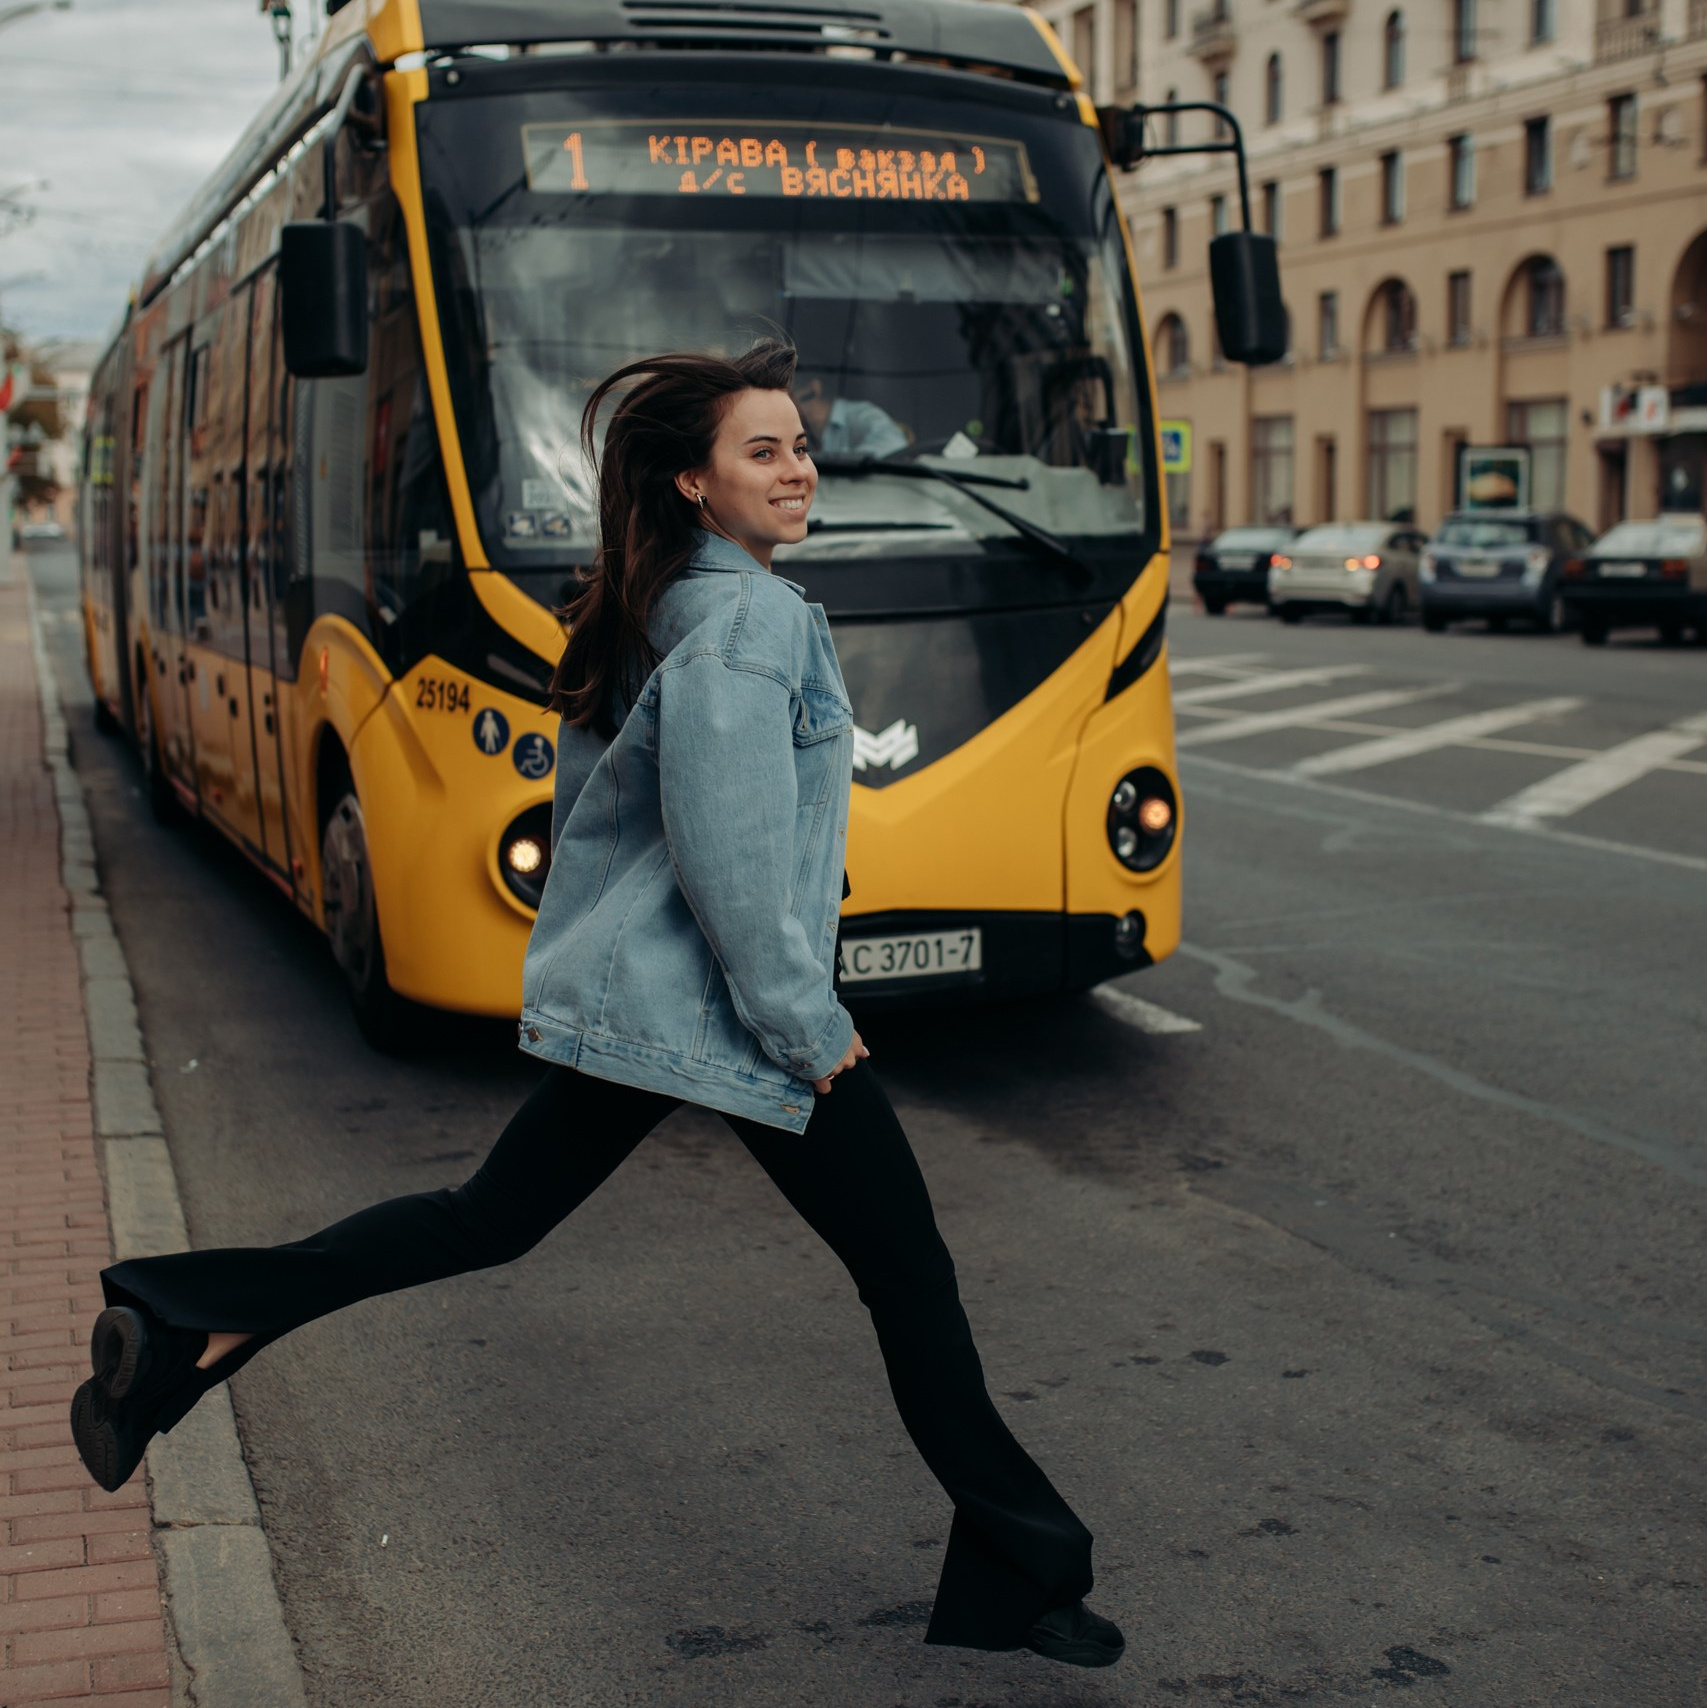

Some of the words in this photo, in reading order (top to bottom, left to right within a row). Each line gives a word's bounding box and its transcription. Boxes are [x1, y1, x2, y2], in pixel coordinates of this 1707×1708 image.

[563, 132, 589, 190] 1
[649, 135, 788, 167] КІРАВА
[781, 166, 969, 200] ВЯСНЯНКА
[415, 678, 470, 713] 25194
[880, 934, 974, 972] 3701-7
